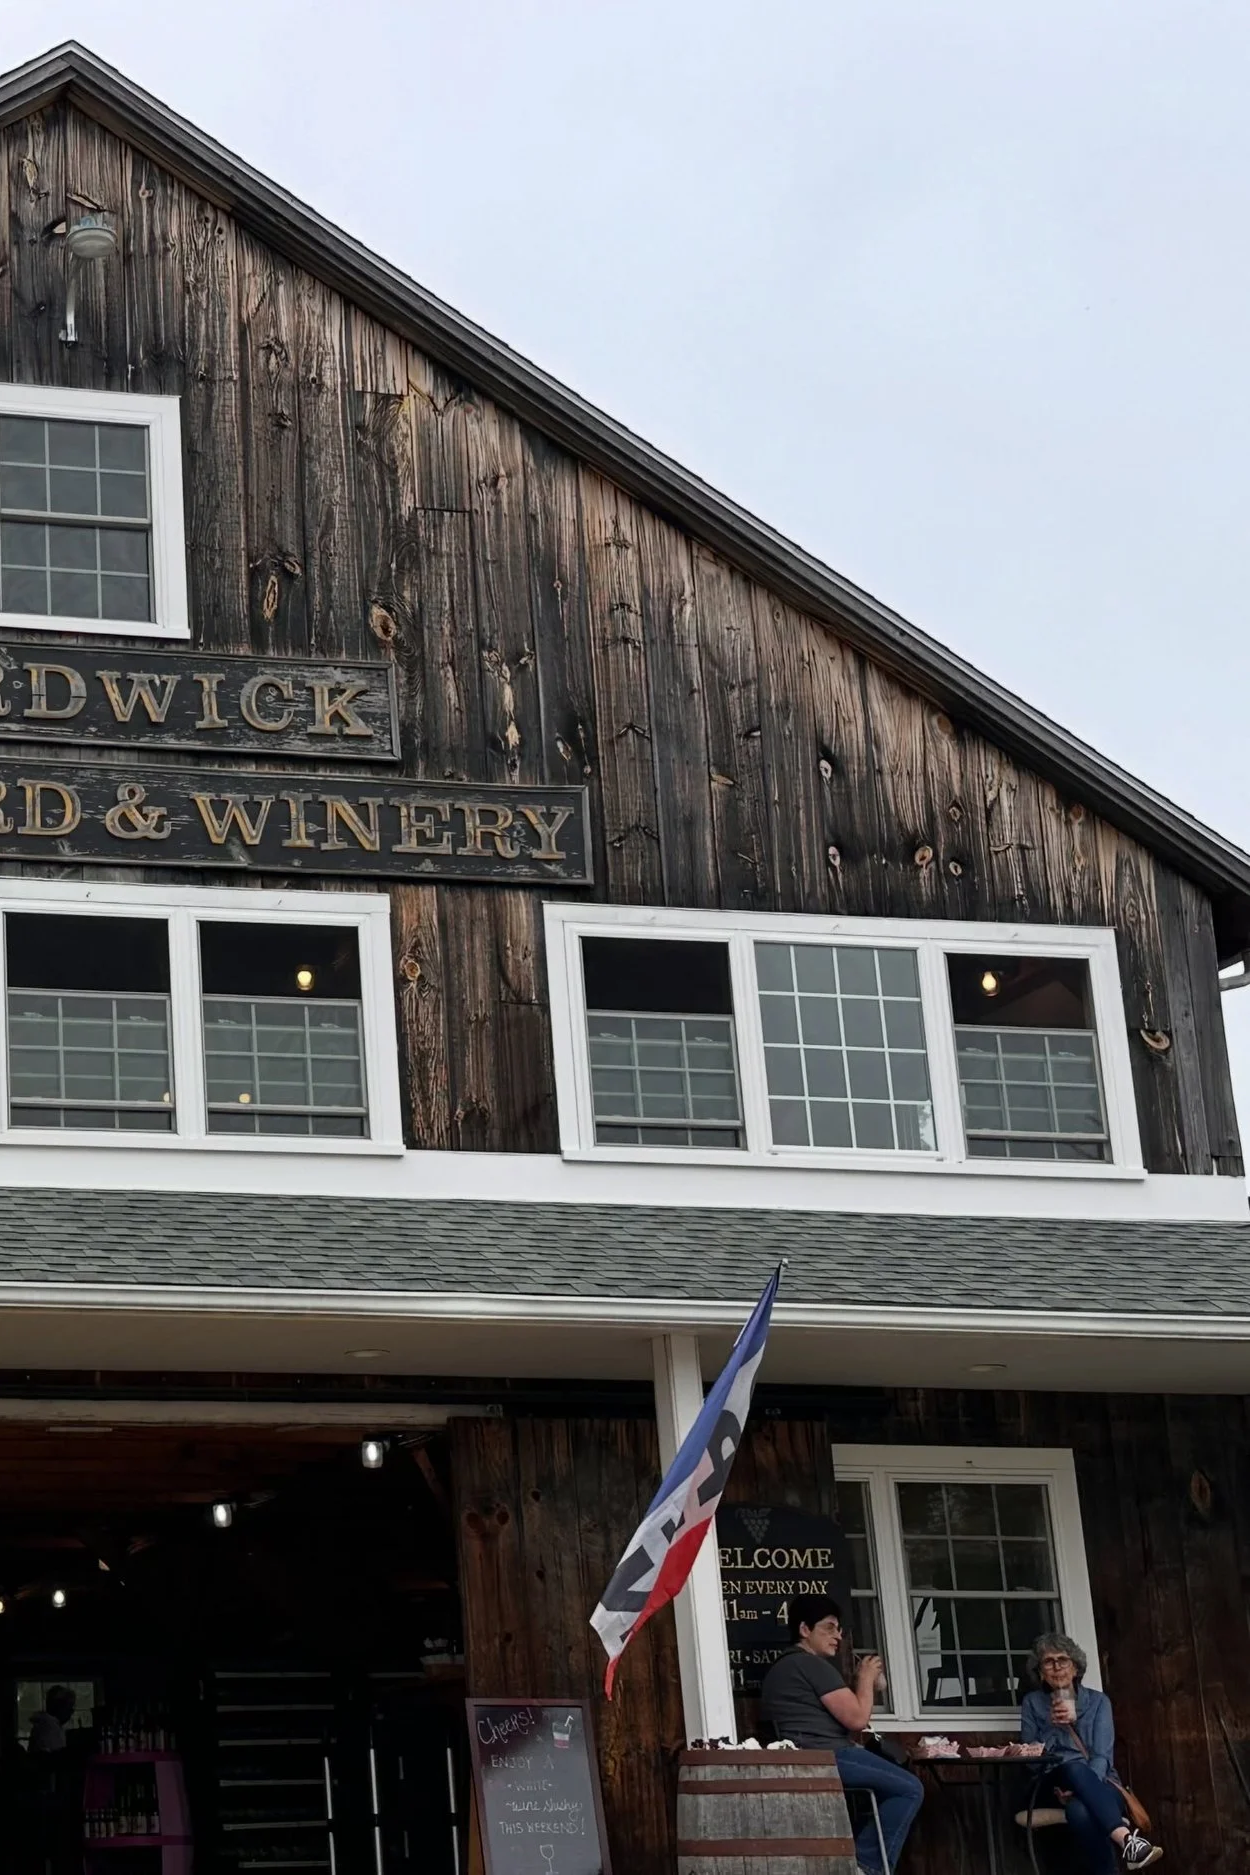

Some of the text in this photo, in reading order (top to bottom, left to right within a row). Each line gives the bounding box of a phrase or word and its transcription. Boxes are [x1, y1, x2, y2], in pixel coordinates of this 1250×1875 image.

[104, 782, 172, 840] &
[189, 791, 575, 860] WINERY
[717, 1547, 834, 1569] ELCOME
[744, 1580, 795, 1595] EVERY
[798, 1580, 829, 1595] DAY
[499, 1821, 524, 1835] THIS
